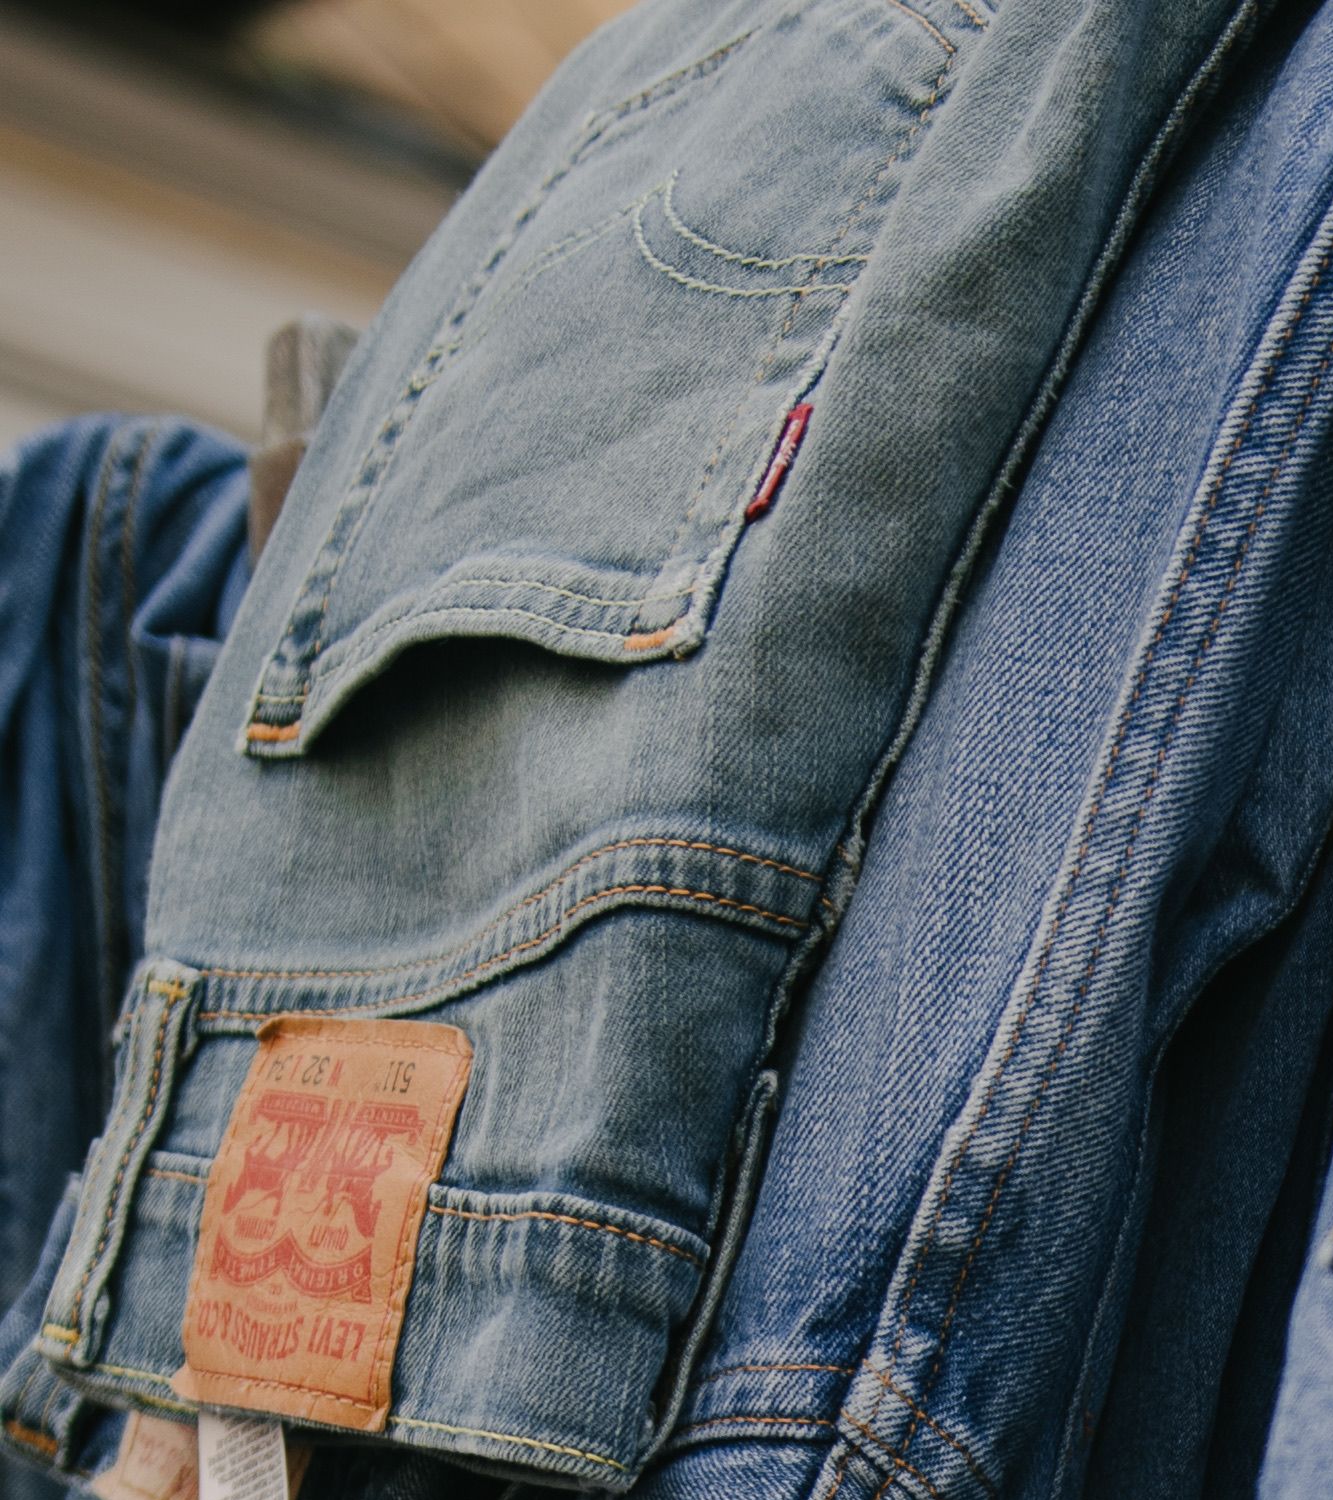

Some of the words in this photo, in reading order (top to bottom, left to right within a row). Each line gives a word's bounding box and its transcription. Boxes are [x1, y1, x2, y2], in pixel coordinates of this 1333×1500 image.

[300, 1055, 330, 1085] 32
[219, 1301, 233, 1340] &
[230, 1307, 304, 1361] STRAUSS
[306, 1314, 367, 1361] LEVI
